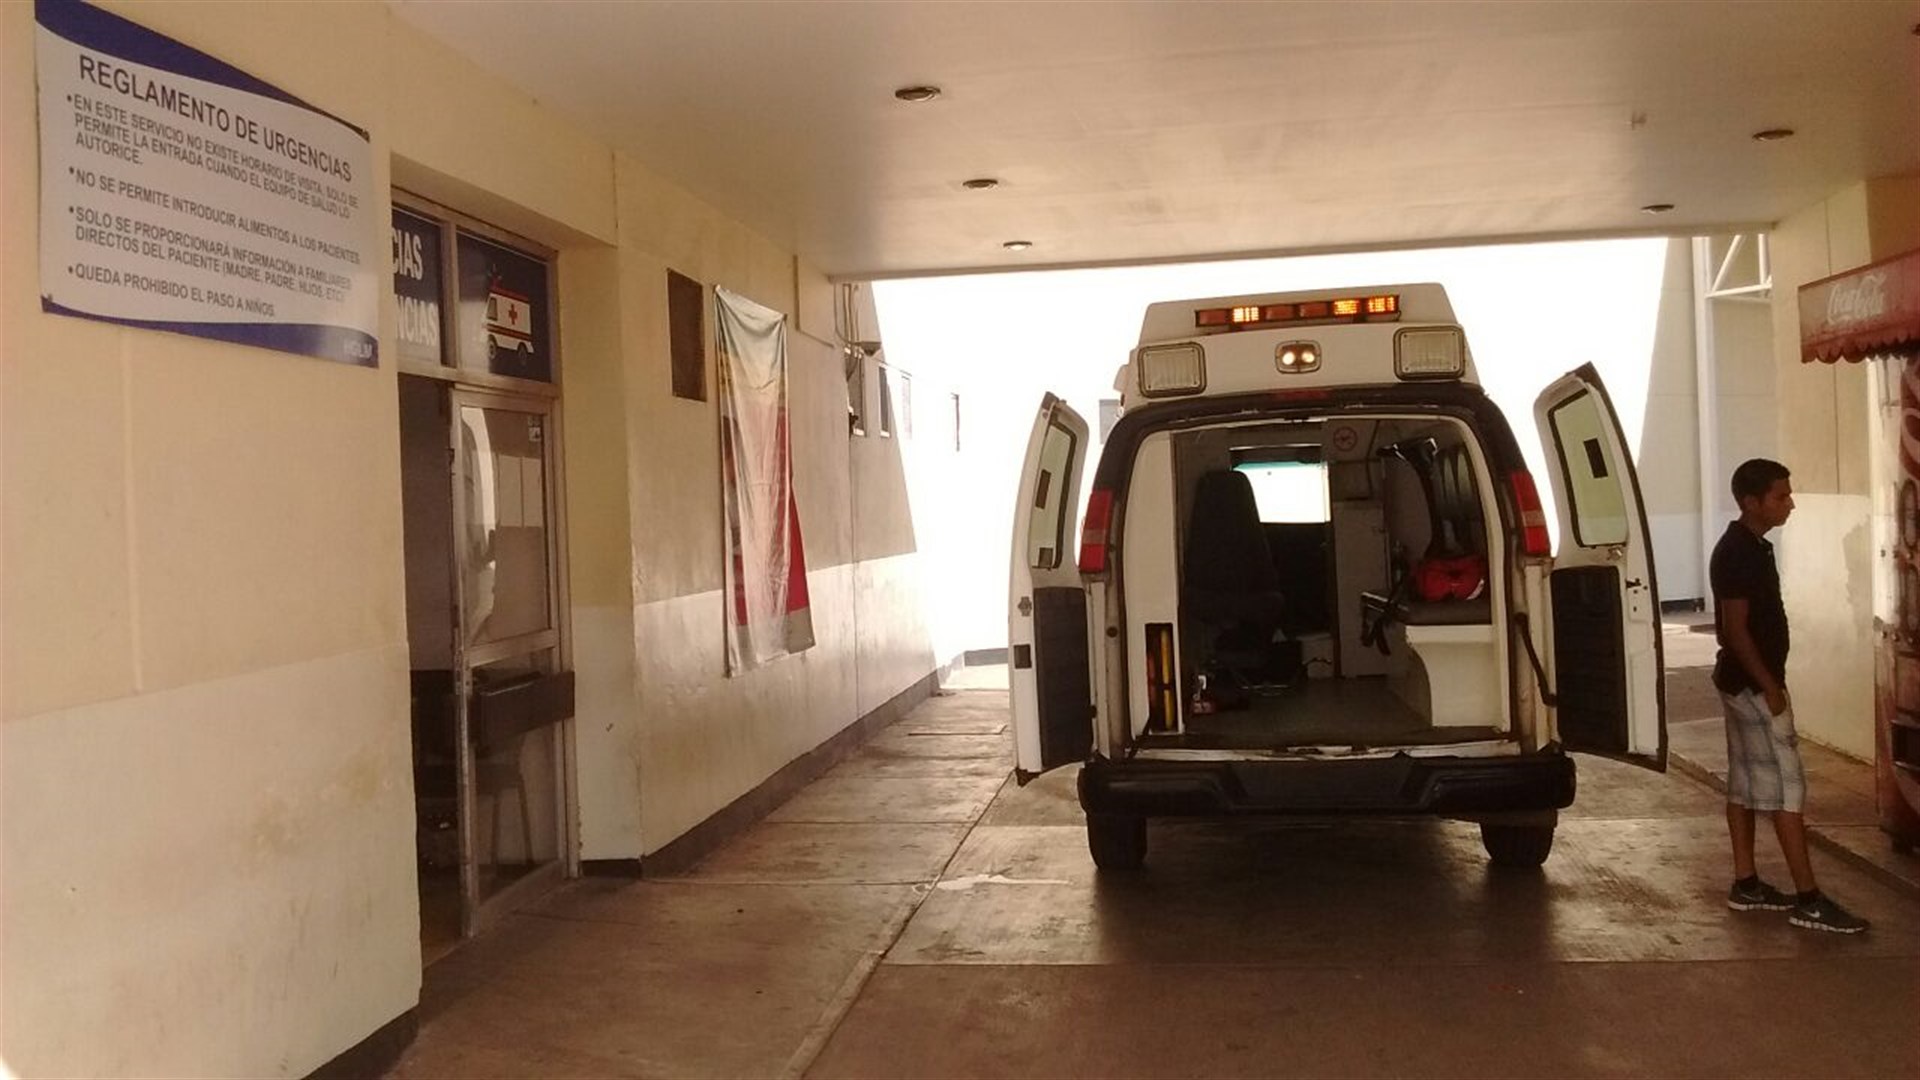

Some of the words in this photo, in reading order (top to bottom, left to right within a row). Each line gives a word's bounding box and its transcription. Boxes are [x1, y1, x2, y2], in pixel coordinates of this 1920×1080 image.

[74, 93, 91, 113] EN
[95, 100, 128, 126] ESTE
[131, 112, 184, 145] SERVICIO
[186, 133, 202, 151] NO
[204, 139, 239, 165] EXISTE
[240, 154, 282, 181] HORARIO
[284, 169, 296, 186] DE
[75, 131, 144, 167] AUTORICE.
[80, 54, 229, 132] REGLAMENTO
[235, 114, 259, 145] DE
[263, 127, 352, 183] URGENCIAS
[74, 112, 130, 145] PERMITE
[133, 131, 149, 150] LA
[150, 137, 203, 168] ENTRADA
[205, 156, 248, 183] CUANDO
[250, 171, 261, 188] EL
[298, 189, 310, 205] DE
[75, 206, 112, 228] SOLO
[115, 216, 132, 233] SE
[298, 263, 305, 278] A
[75, 225, 139, 254] DIRECTOS
[142, 241, 165, 260] DEL
[167, 247, 221, 273] PACIENTE
[76, 169, 96, 188] NO
[99, 174, 116, 194] SE
[118, 180, 170, 209] PERMITE
[172, 195, 237, 228] INTRODUCIR
[238, 217, 290, 244] ALIMENTOS
[292, 232, 299, 247] A
[300, 235, 316, 252] LOS
[75, 263, 121, 287] QUEDA
[123, 272, 189, 300] PROHIBIDO
[191, 287, 204, 303] EL
[206, 290, 235, 310] PASO
[237, 297, 244, 311] A
